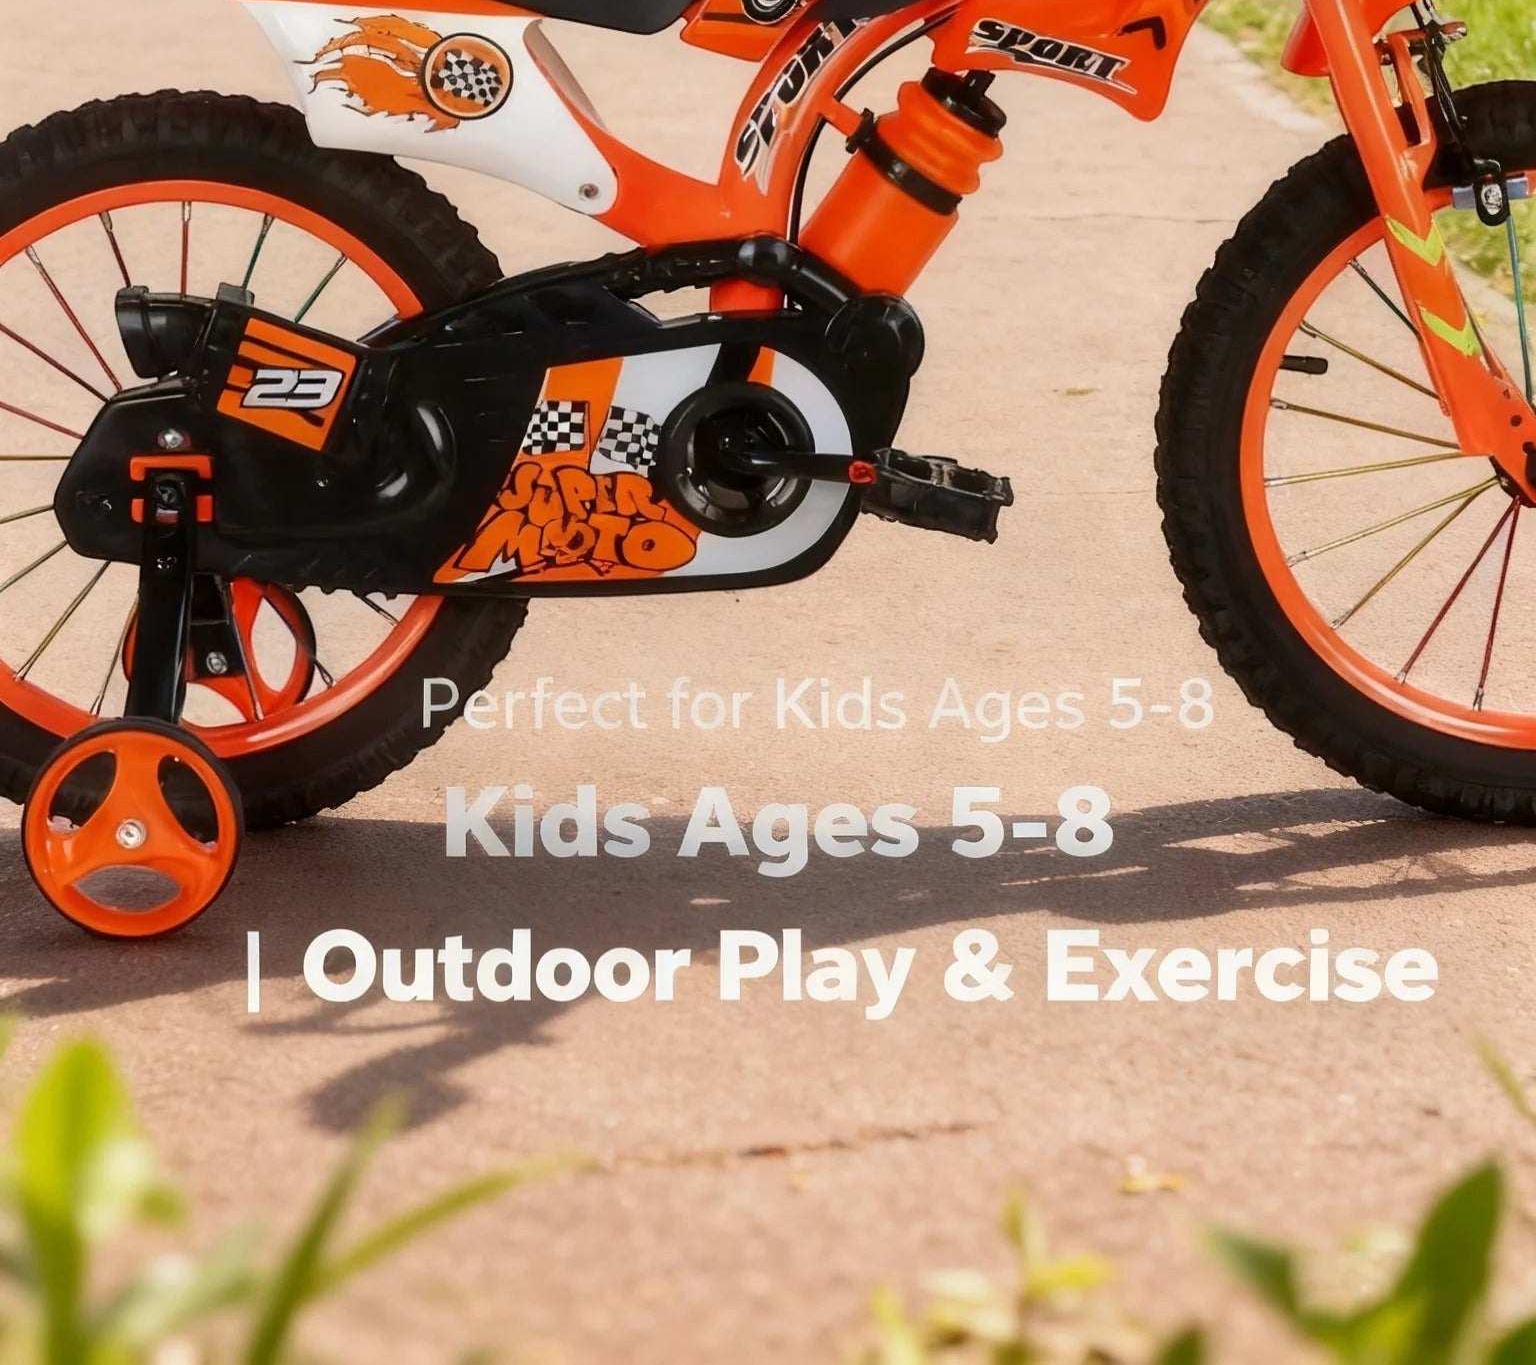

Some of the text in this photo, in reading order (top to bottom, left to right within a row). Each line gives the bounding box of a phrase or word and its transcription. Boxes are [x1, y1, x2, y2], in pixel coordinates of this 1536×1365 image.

[971, 18, 1129, 82] SPORT
[241, 367, 345, 409] 23
[498, 460, 668, 528] SUPER
